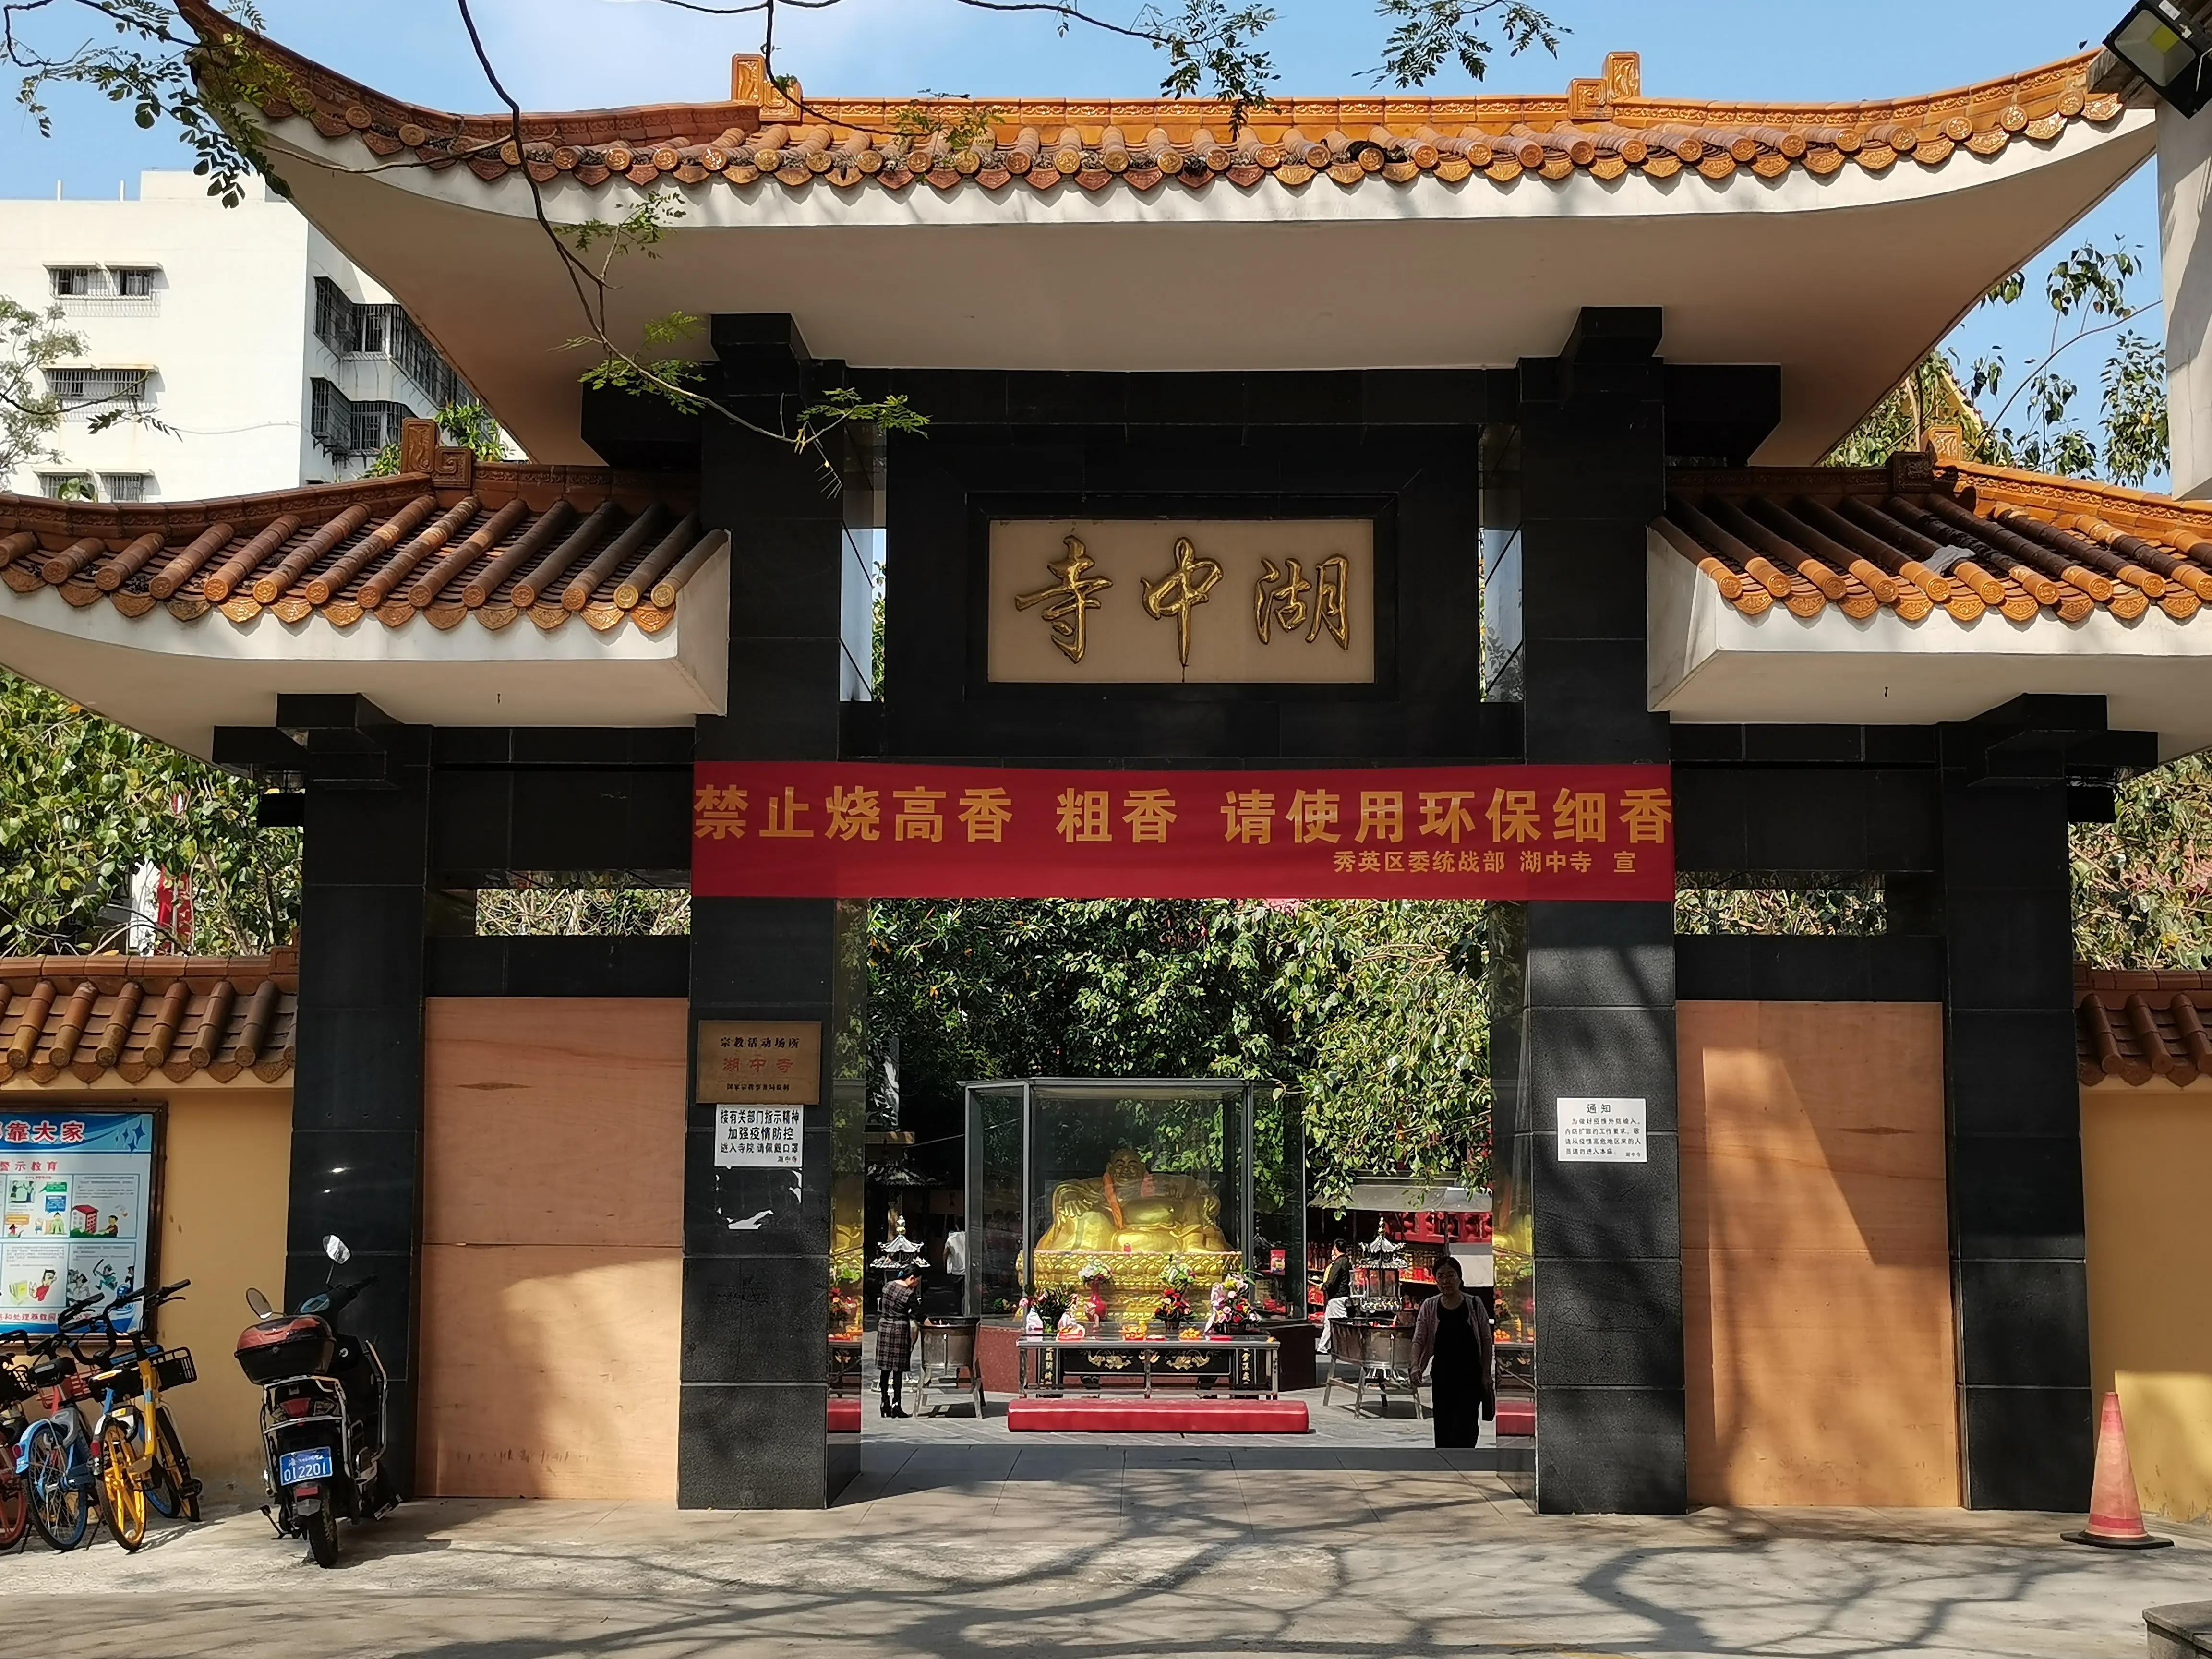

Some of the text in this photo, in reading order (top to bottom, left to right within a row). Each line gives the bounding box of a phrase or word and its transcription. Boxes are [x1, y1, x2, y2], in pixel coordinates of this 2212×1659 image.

[694, 784, 1672, 844] 禁止烧高香 粗香 请使用环保细香
[1333, 850, 1636, 874] 秀英区委统战部 湖中寺 宣
[721, 1036, 799, 1049] 宗教活动场所
[722, 1058, 793, 1073] 湖中寺
[1587, 1104, 1611, 1114] 通知
[0, 1120, 85, 1142] 靠大家
[728, 1126, 793, 1141] 加强疫情防控
[284, 1461, 326, 1481] 012201
